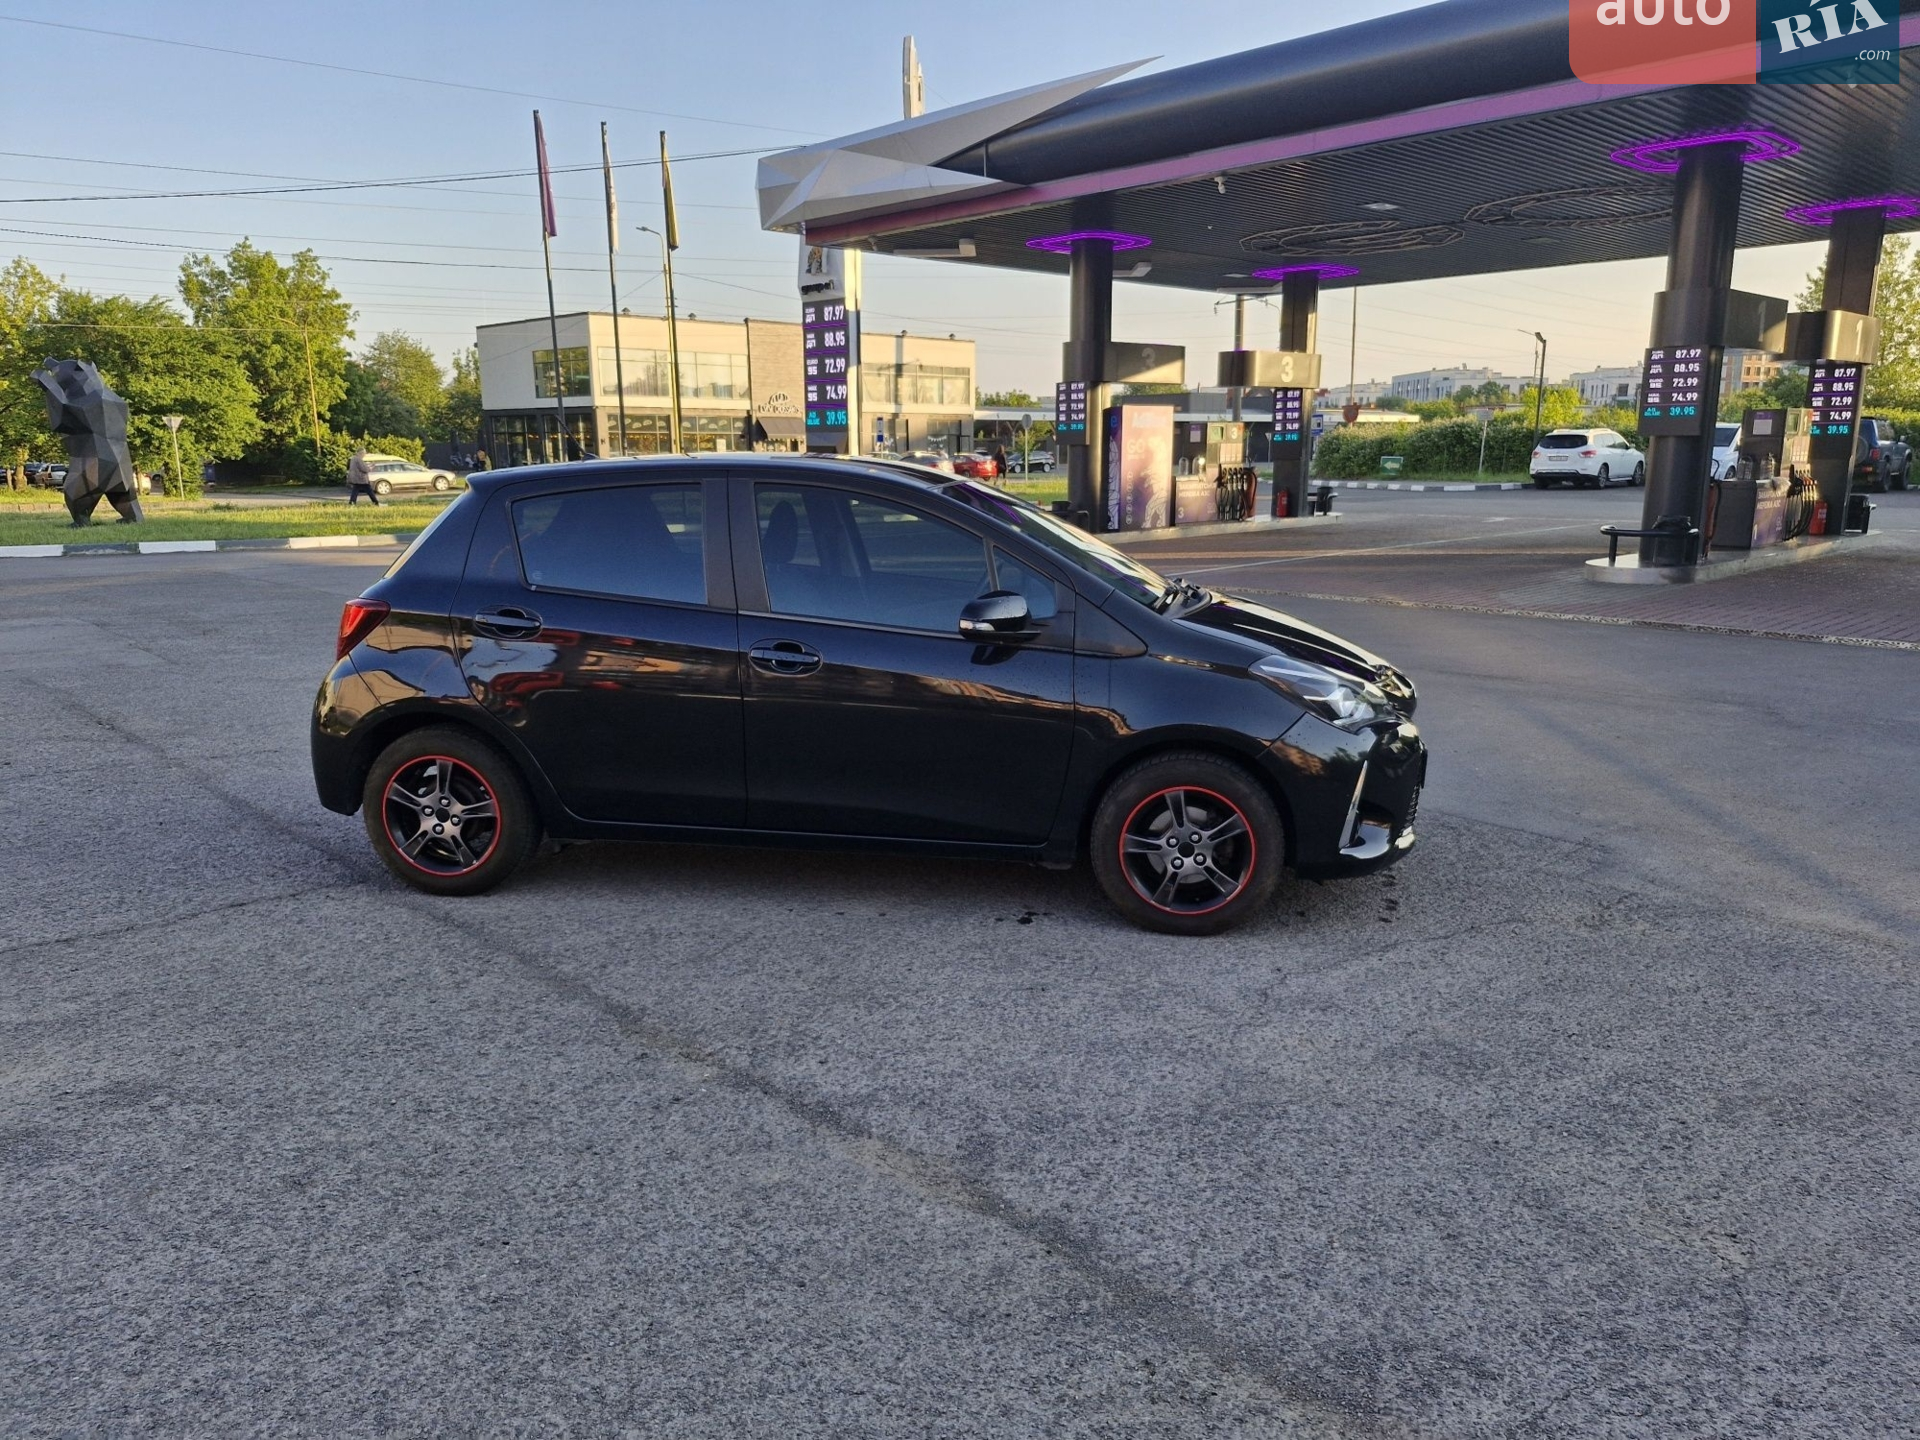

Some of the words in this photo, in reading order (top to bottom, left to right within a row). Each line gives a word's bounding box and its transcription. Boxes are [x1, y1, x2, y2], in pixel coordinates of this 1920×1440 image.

[823, 305, 845, 322] 87.97
[1758, 301, 1766, 342] 1
[824, 331, 846, 348] 88.95
[1856, 319, 1863, 355] 1
[1675, 349, 1702, 359] 87.97
[807, 366, 818, 375] 95
[825, 358, 846, 374] 72.99
[1281, 356, 1294, 382] 3
[1674, 363, 1700, 373] 88.95
[1834, 368, 1856, 378] 87.97
[1672, 378, 1698, 387] 72.99
[1832, 382, 1854, 392] 88.95
[807, 392, 818, 402] 95
[826, 385, 847, 400] 74.99
[1672, 393, 1698, 402] 74.99
[1830, 397, 1853, 406] 72.99
[1669, 406, 1695, 416] 39.95
[1830, 411, 1852, 420] 74.99
[826, 411, 847, 425] 39.95
[1070, 413, 1085, 421] 74.99
[1231, 427, 1238, 440] 3
[1827, 425, 1849, 434] 39.95
[1178, 507, 1185, 520] 3
